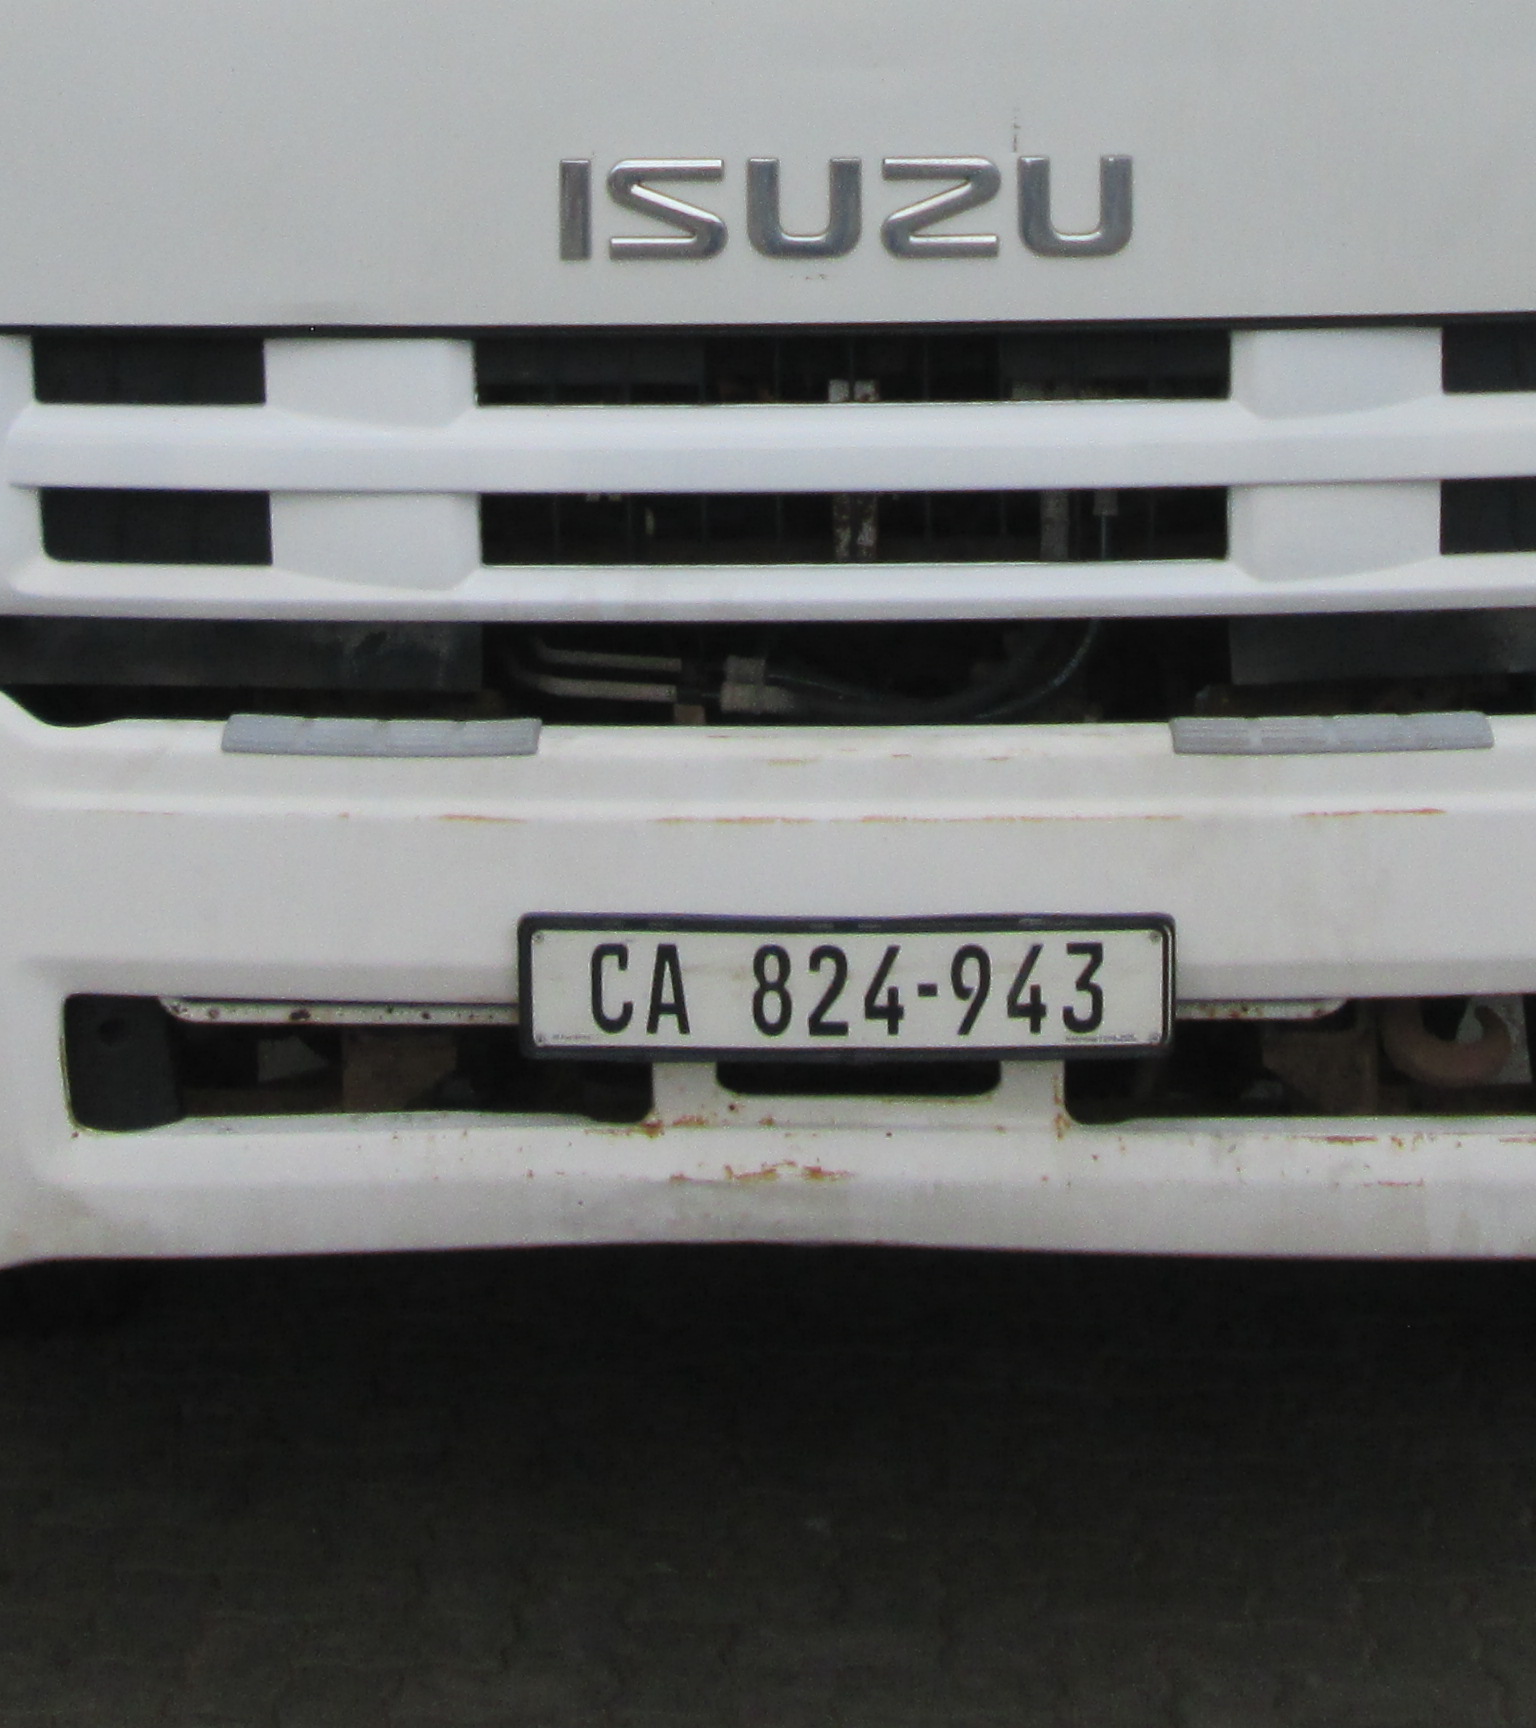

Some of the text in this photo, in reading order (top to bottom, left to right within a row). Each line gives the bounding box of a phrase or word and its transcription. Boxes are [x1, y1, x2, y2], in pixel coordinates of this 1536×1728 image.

[558, 154, 1134, 261] ISUZU
[589, 942, 1106, 1037] CA 824-943
